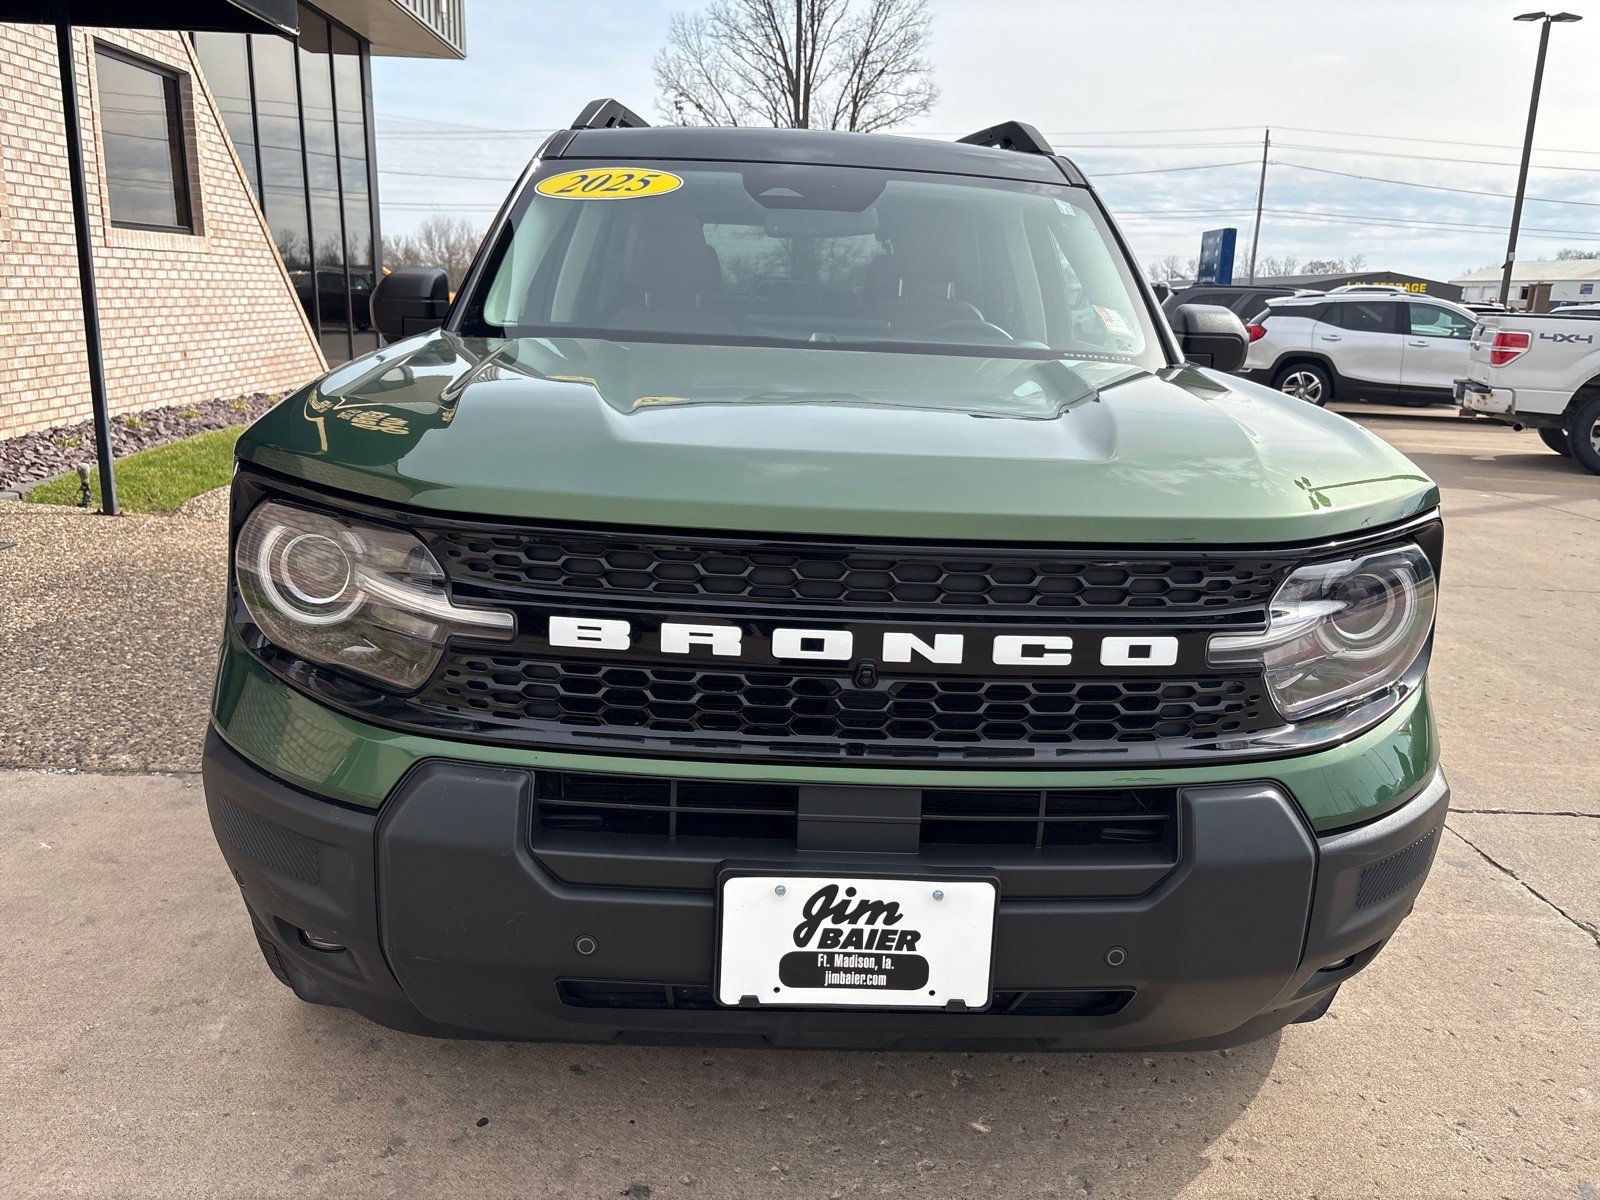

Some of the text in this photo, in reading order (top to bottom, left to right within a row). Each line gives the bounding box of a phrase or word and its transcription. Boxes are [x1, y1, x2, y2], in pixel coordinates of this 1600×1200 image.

[554, 174, 660, 193] 2025
[549, 615, 1179, 667] BRONCO
[793, 884, 903, 948] Jim
[817, 928, 921, 952] BAIER
[817, 953, 830, 968] Ft.
[834, 954, 878, 970] Madison,
[824, 970, 887, 987] jimbaier.com
